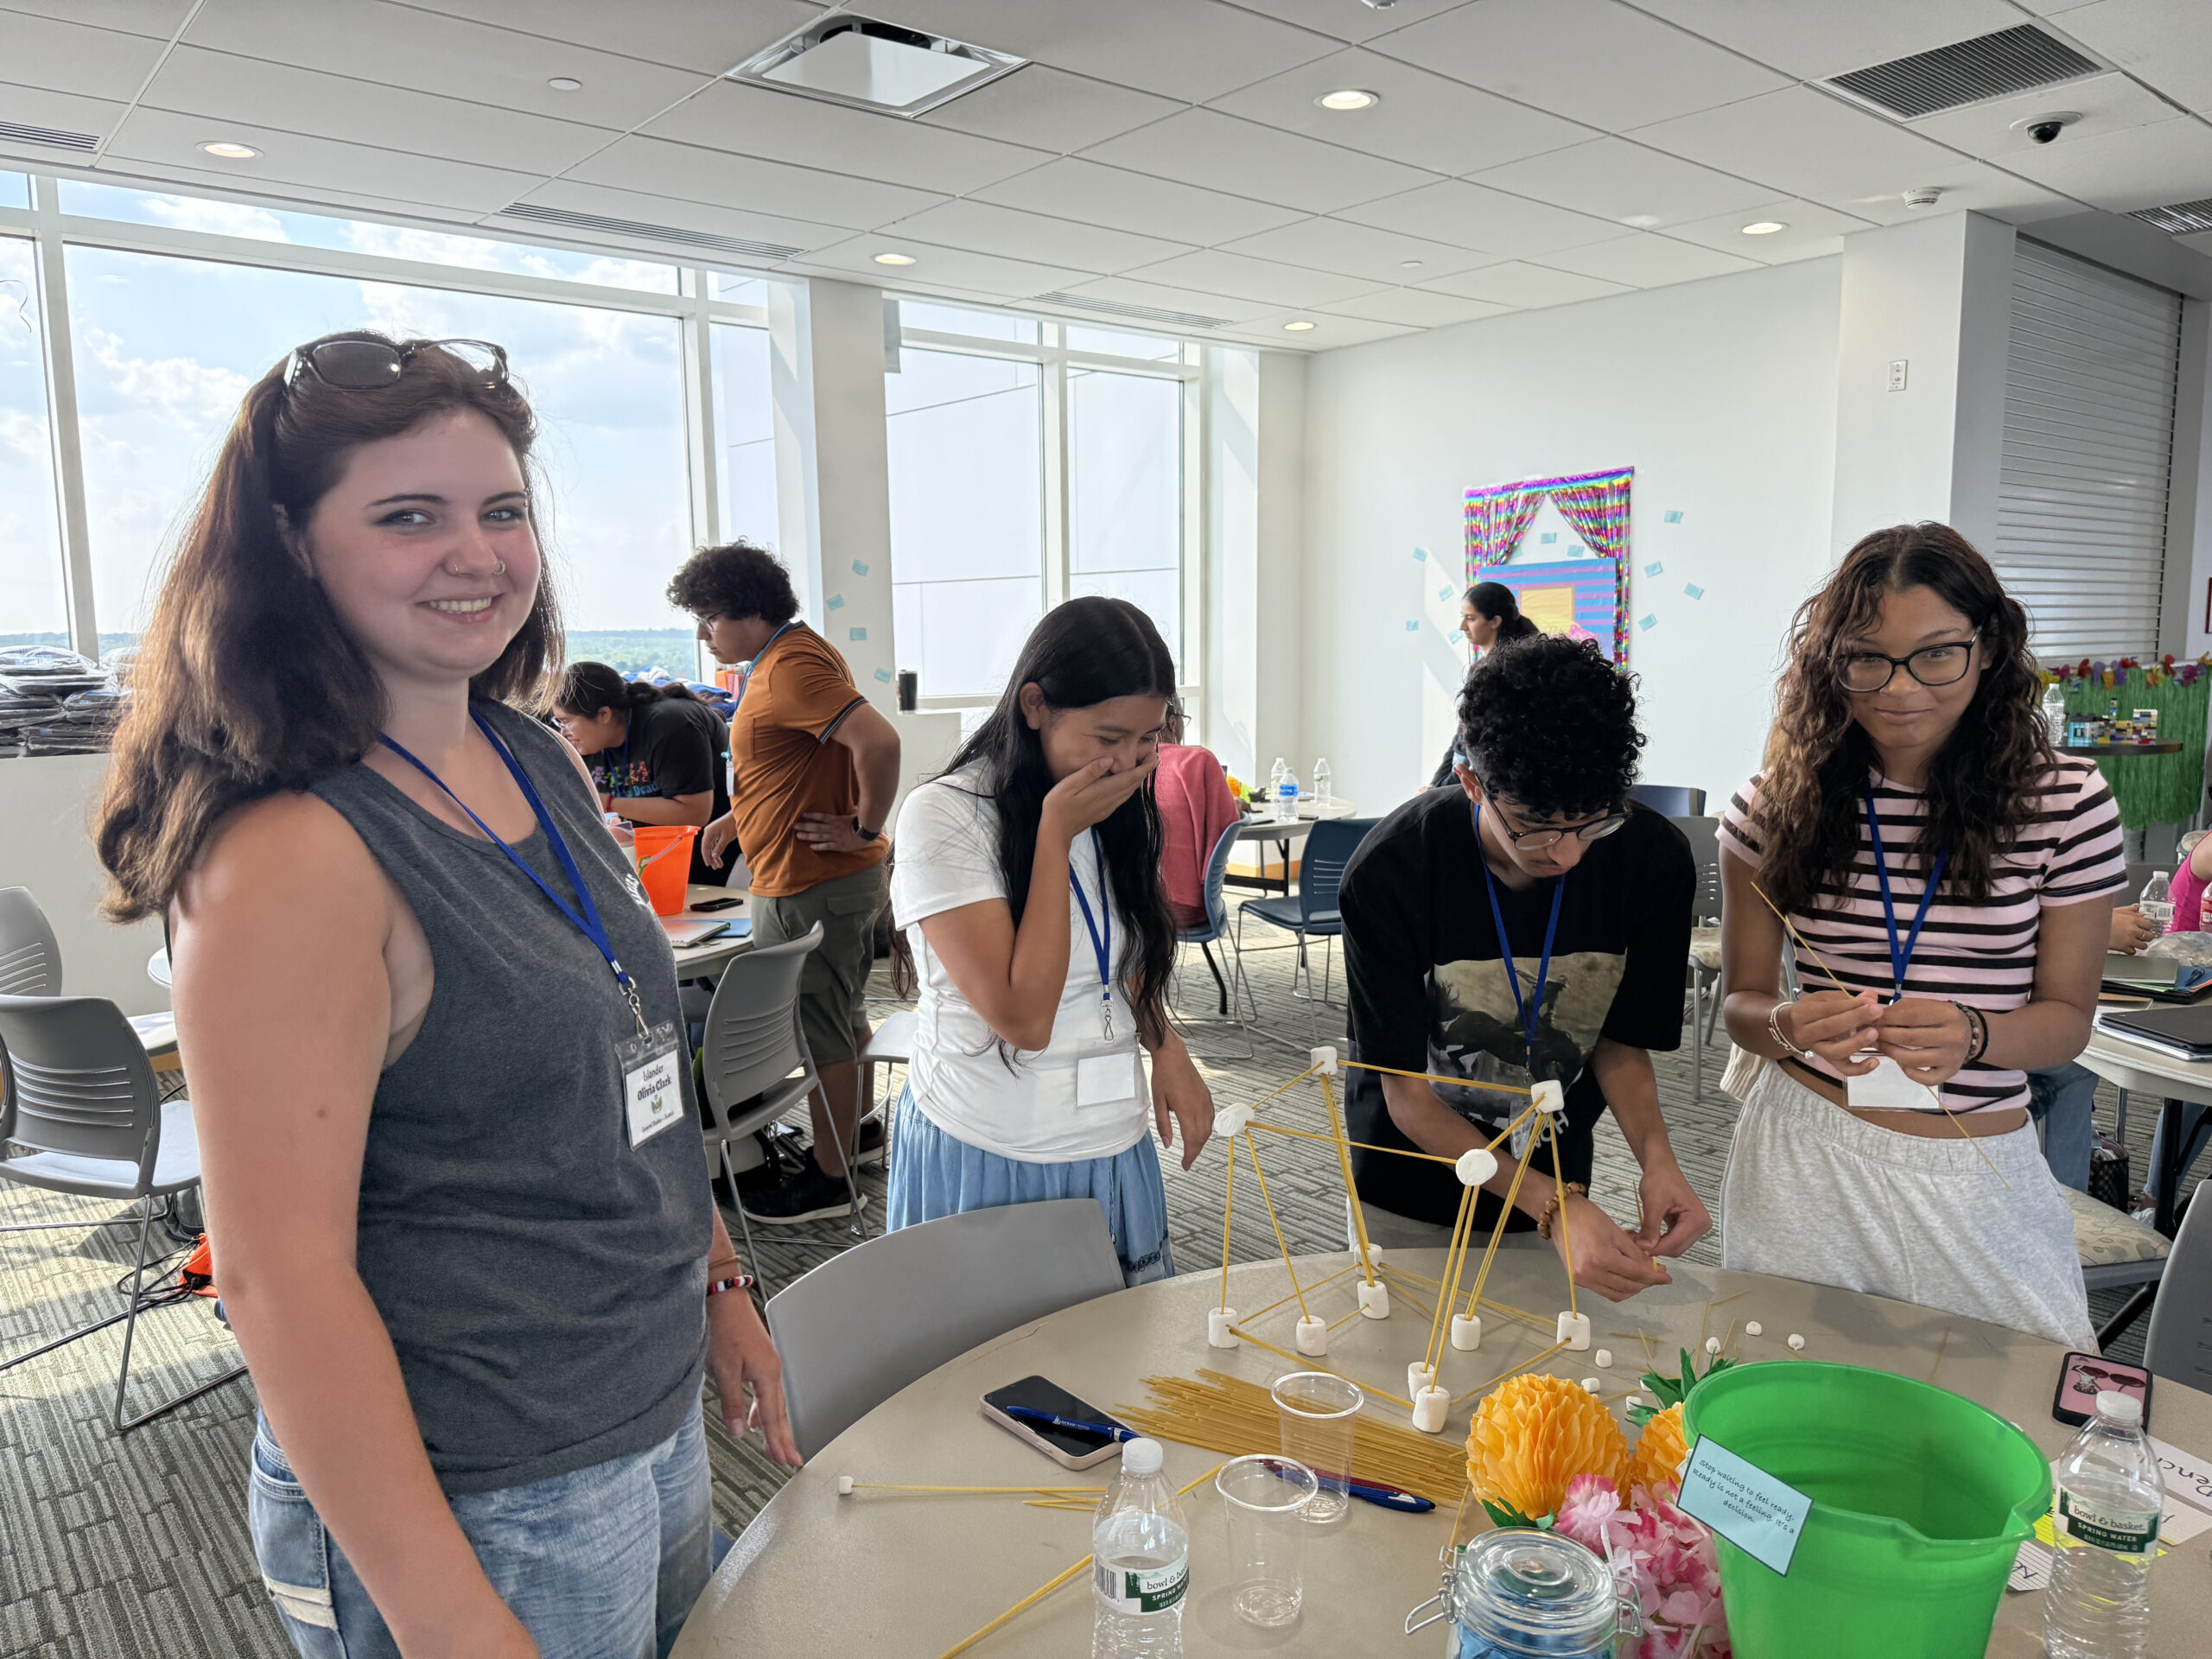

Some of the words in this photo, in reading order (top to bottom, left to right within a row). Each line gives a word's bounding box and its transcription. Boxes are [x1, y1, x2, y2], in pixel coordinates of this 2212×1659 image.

[643, 1065, 664, 1081] Islander
[637, 1083, 656, 1101] Olivia
[656, 1075, 671, 1090] Clark
[1692, 1468, 1715, 1489] Ready
[1717, 1483, 1724, 1491] is
[1725, 1490, 1738, 1500] not
[1745, 1500, 1773, 1522] feeling.
[1775, 1518, 1788, 1530] It's
[1699, 1459, 1715, 1473] Stop
[1717, 1469, 1745, 1492] waiting
[1746, 1486, 1754, 1496] to
[1755, 1492, 1769, 1504] feel
[1770, 1503, 1794, 1522] ready.
[1722, 1499, 1755, 1523] decision.
[2074, 1506, 2096, 1521] bowl
[2077, 1522, 2107, 1536] SPRING
[2109, 1533, 2137, 1542] WATER
[1146, 1577, 1167, 1590] bowl
[1169, 1574, 1175, 1584] &
[1152, 1588, 1176, 1601] SPRING
